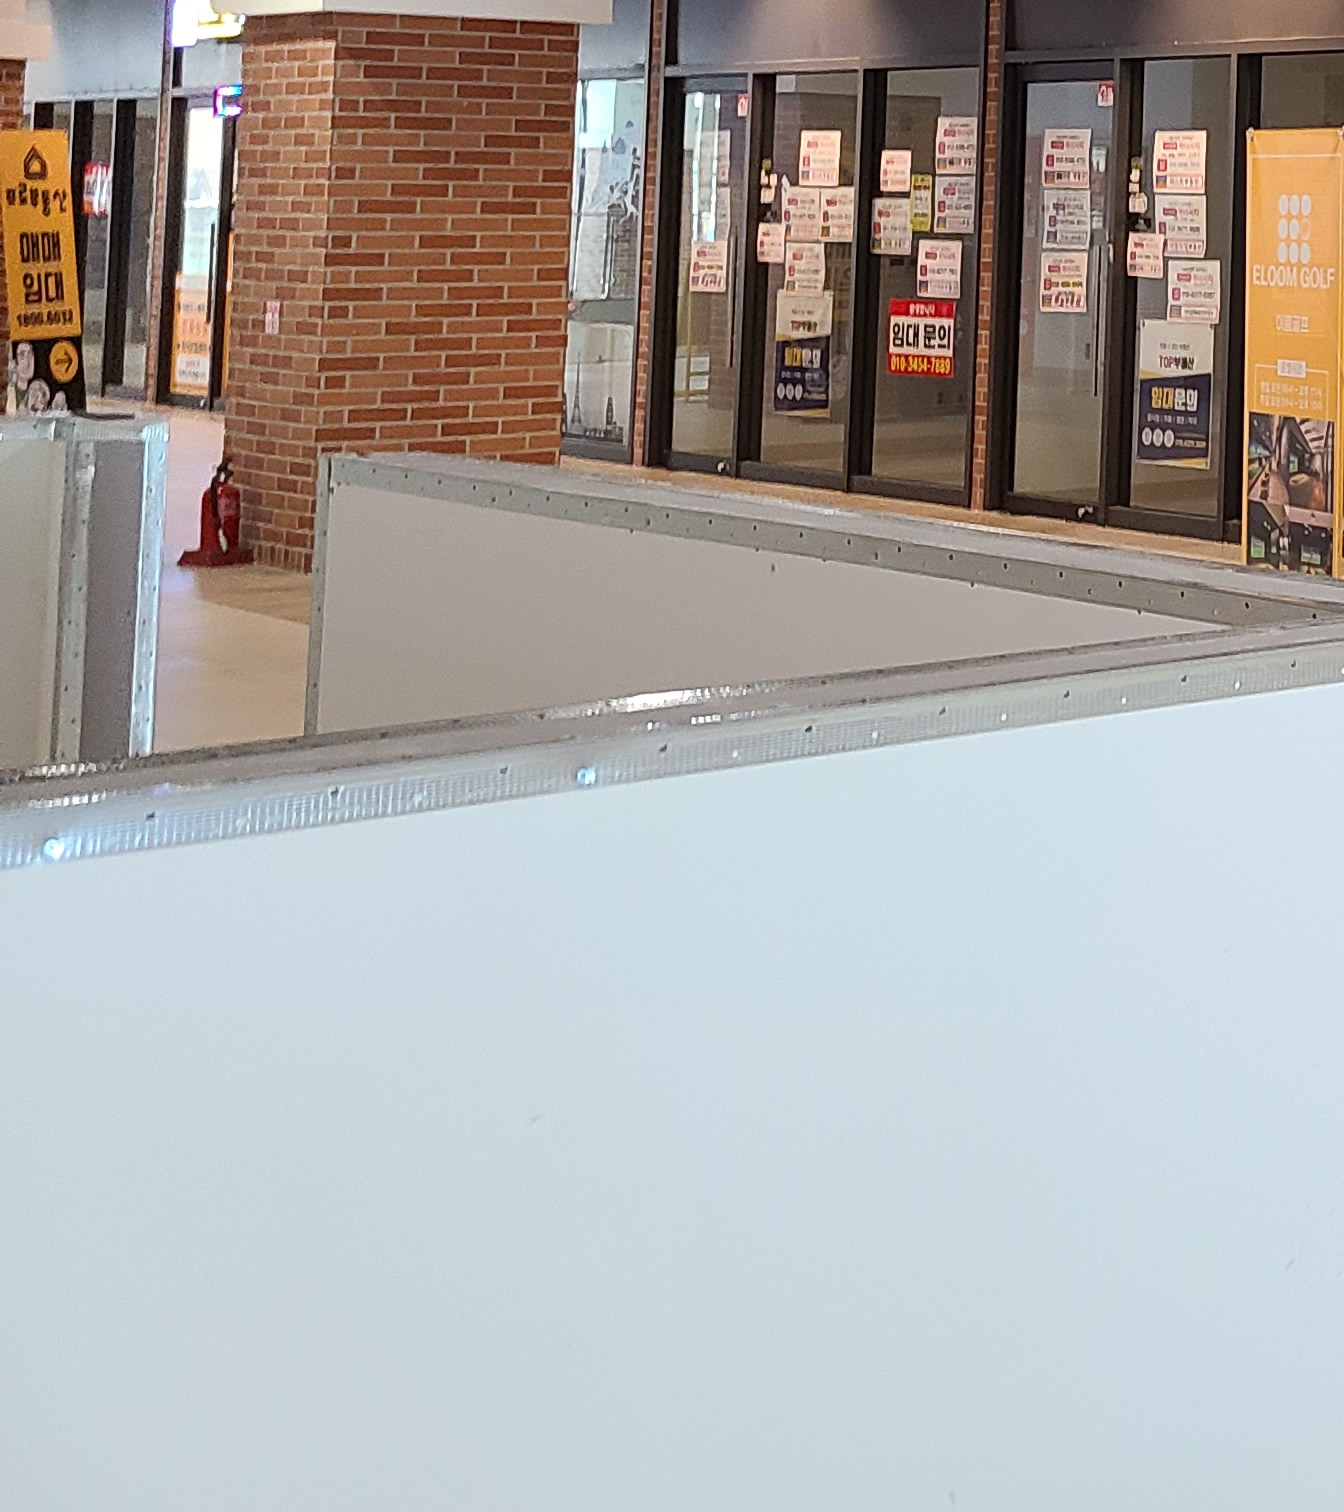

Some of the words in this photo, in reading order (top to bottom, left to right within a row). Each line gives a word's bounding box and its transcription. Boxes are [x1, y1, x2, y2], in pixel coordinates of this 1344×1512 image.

[22, 272, 64, 304] 임대
[1252, 264, 1296, 287] ELOOM
[1299, 267, 1335, 289] GOLF
[891, 322, 919, 349] 임대
[923, 324, 951, 350] 문의
